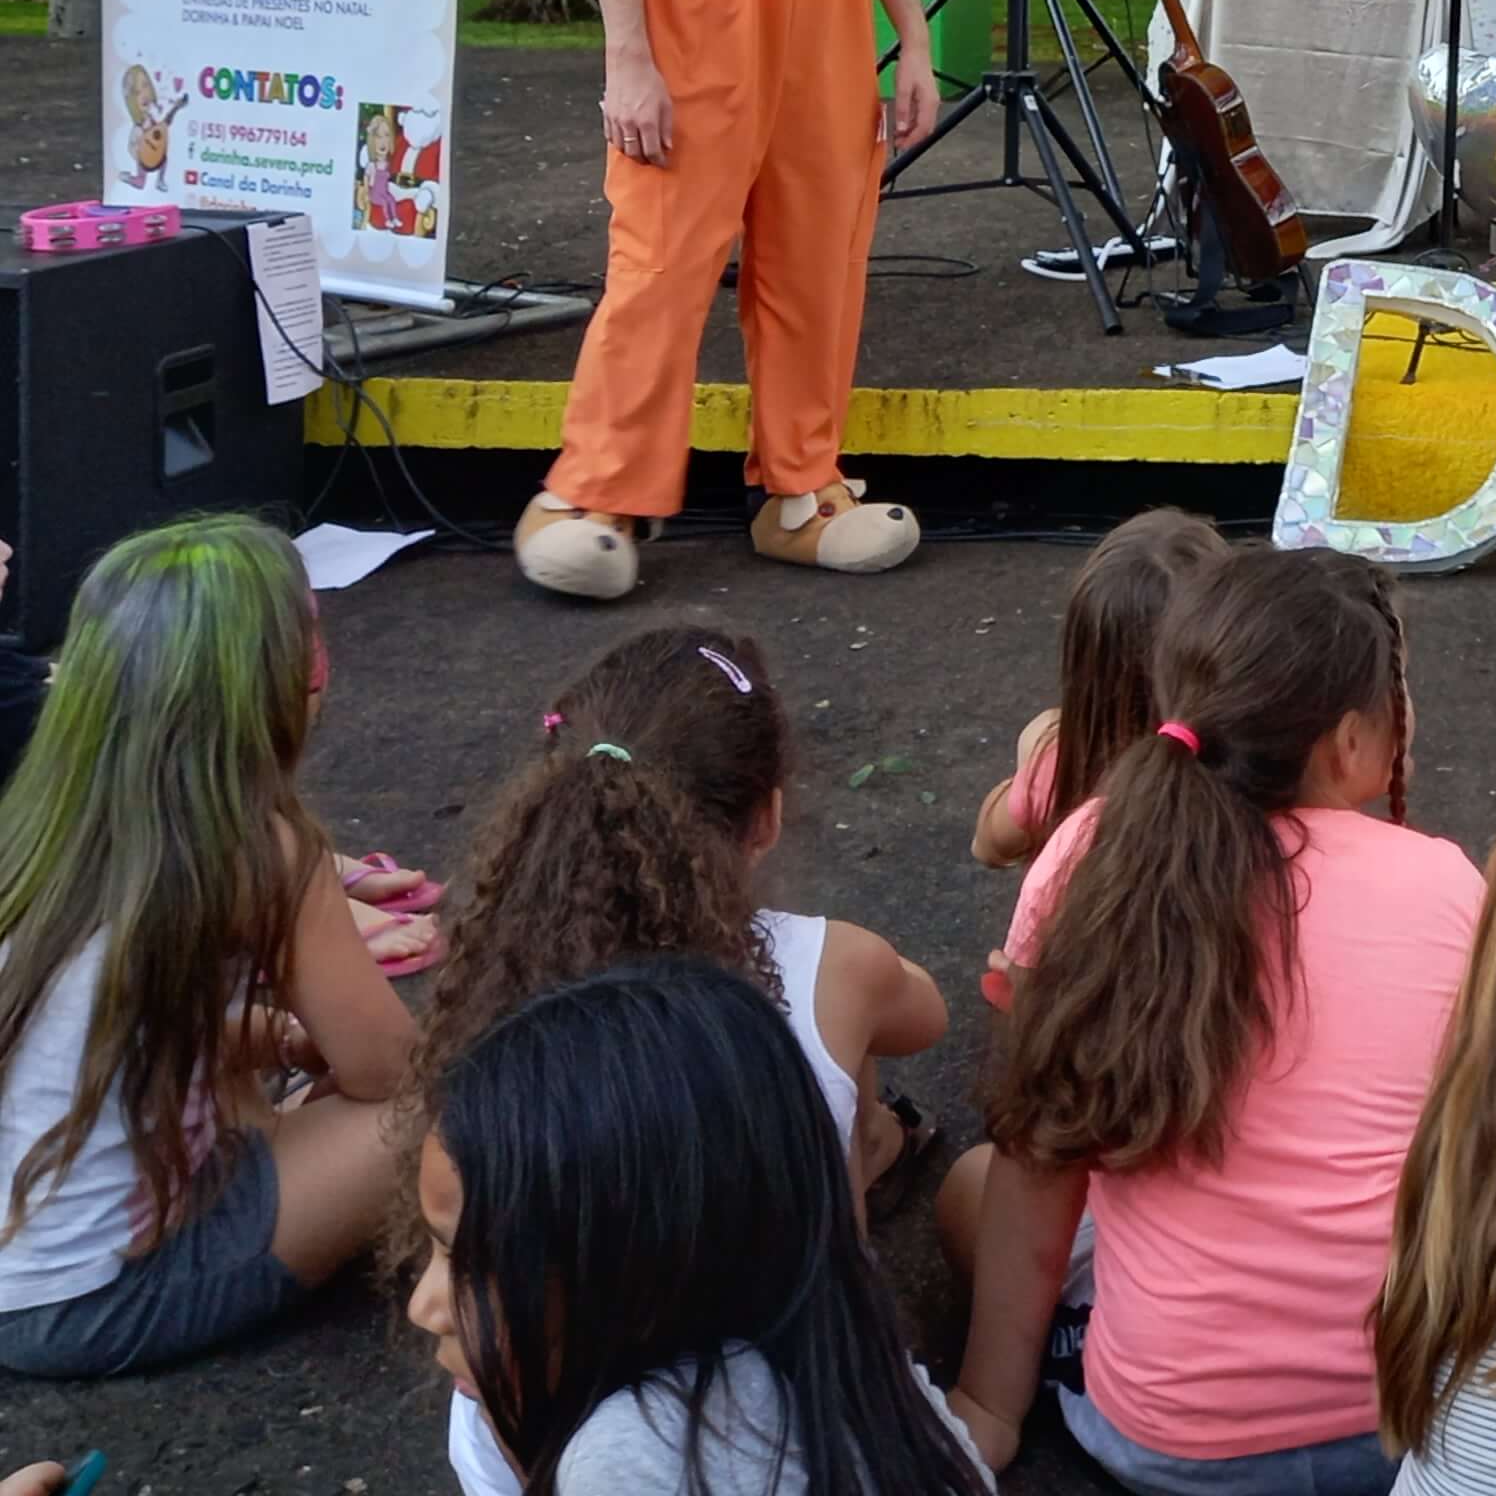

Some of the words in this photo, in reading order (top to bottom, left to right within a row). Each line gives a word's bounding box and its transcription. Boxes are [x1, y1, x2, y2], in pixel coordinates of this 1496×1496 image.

[182, 9, 229, 24] DORINHA
[241, 12, 272, 28] PAPAI
[274, 15, 305, 30] NOEL
[313, 0, 333, 14] NO
[198, 66, 344, 110] CONTATOS:
[201, 122, 226, 143] (55)
[229, 124, 308, 147] 996779164
[200, 171, 235, 189] Canal
[238, 175, 257, 192] da
[260, 178, 313, 199] Dorinha
